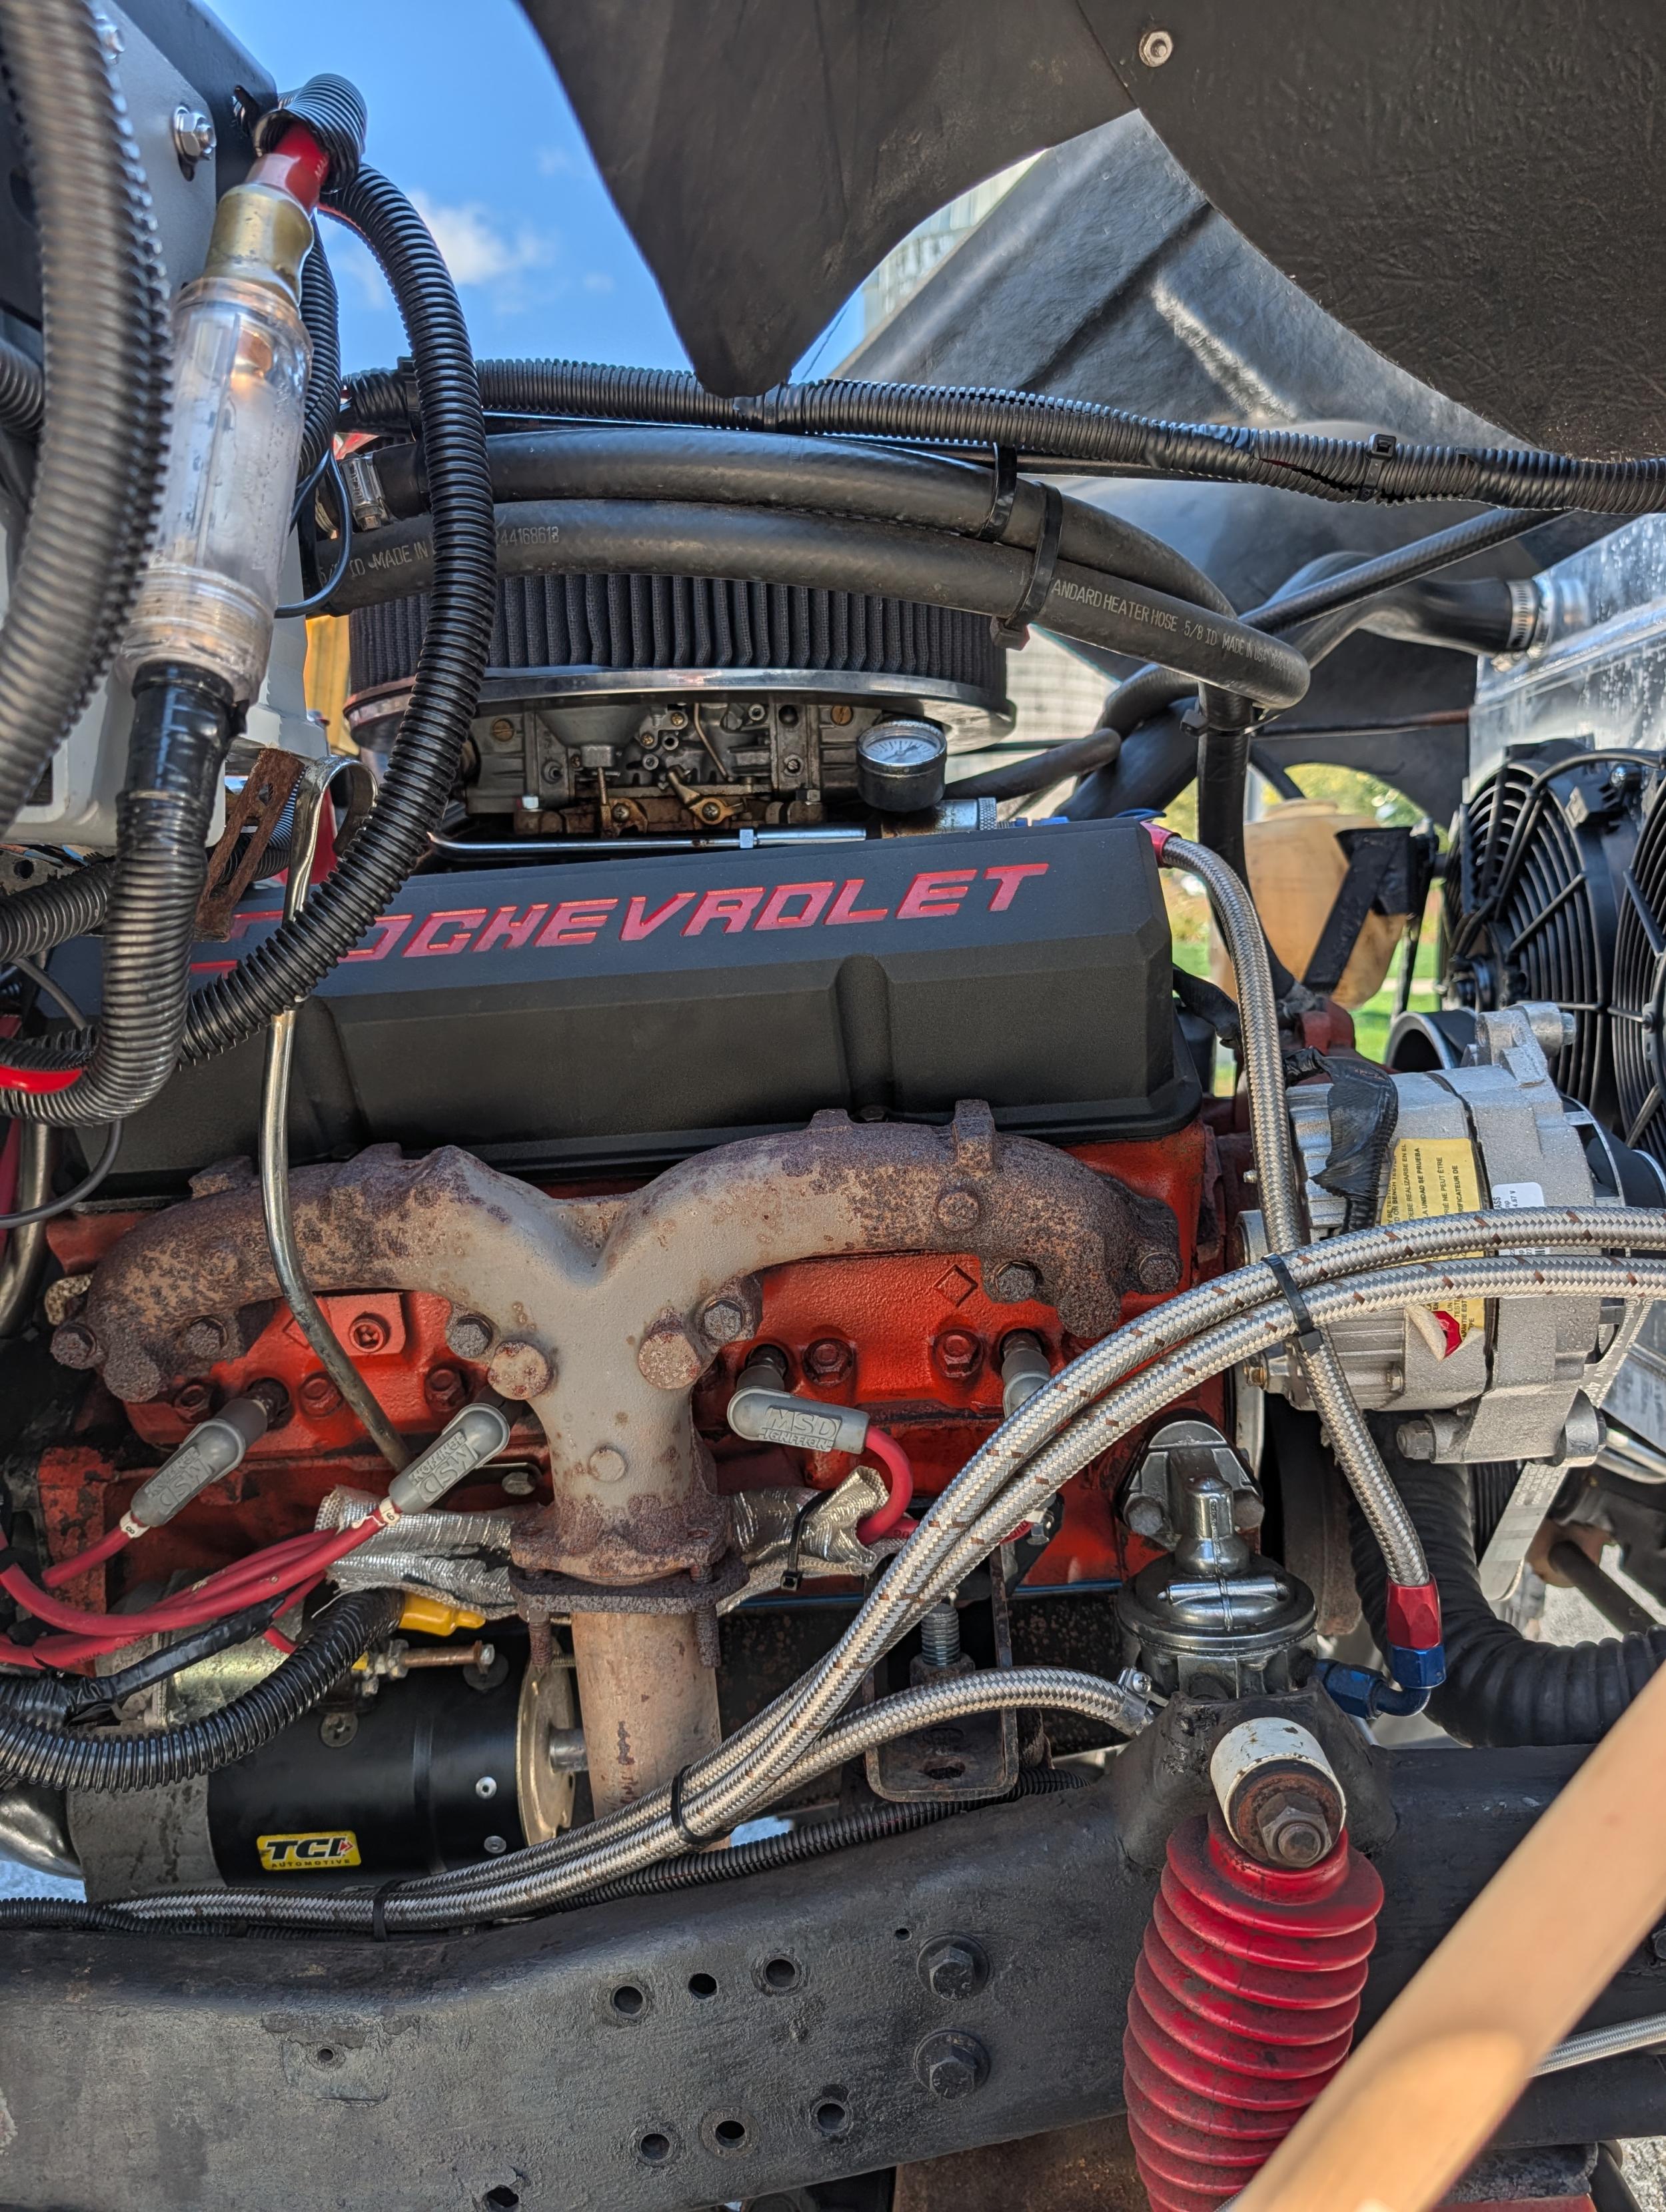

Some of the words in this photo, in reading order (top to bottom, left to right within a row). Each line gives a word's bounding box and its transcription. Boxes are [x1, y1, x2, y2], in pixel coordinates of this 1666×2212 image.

[371, 545, 412, 570] MADE
[414, 541, 428, 560] IN
[1103, 594, 1150, 622] HEATER
[1150, 609, 1179, 632] HOSE
[1184, 620, 1204, 640] 5/8
[1205, 628, 1217, 646] ID
[1222, 633, 1245, 655] MADE
[1246, 642, 1253, 658] IN
[1402, 1153, 1408, 1162] EN
[1413, 1147, 1423, 1173] PRUEBA
[1451, 1165, 1459, 1173] DE
[1403, 1163, 1413, 1202] REALIZARSE
[1439, 1175, 1448, 1193] PEUT
[1419, 1185, 1427, 1209] UNIDAD
[771, 1407, 838, 1440] MSD
[267, 1837, 347, 1860] TCI
[271, 1859, 351, 1868] AUTOMOTIVE
